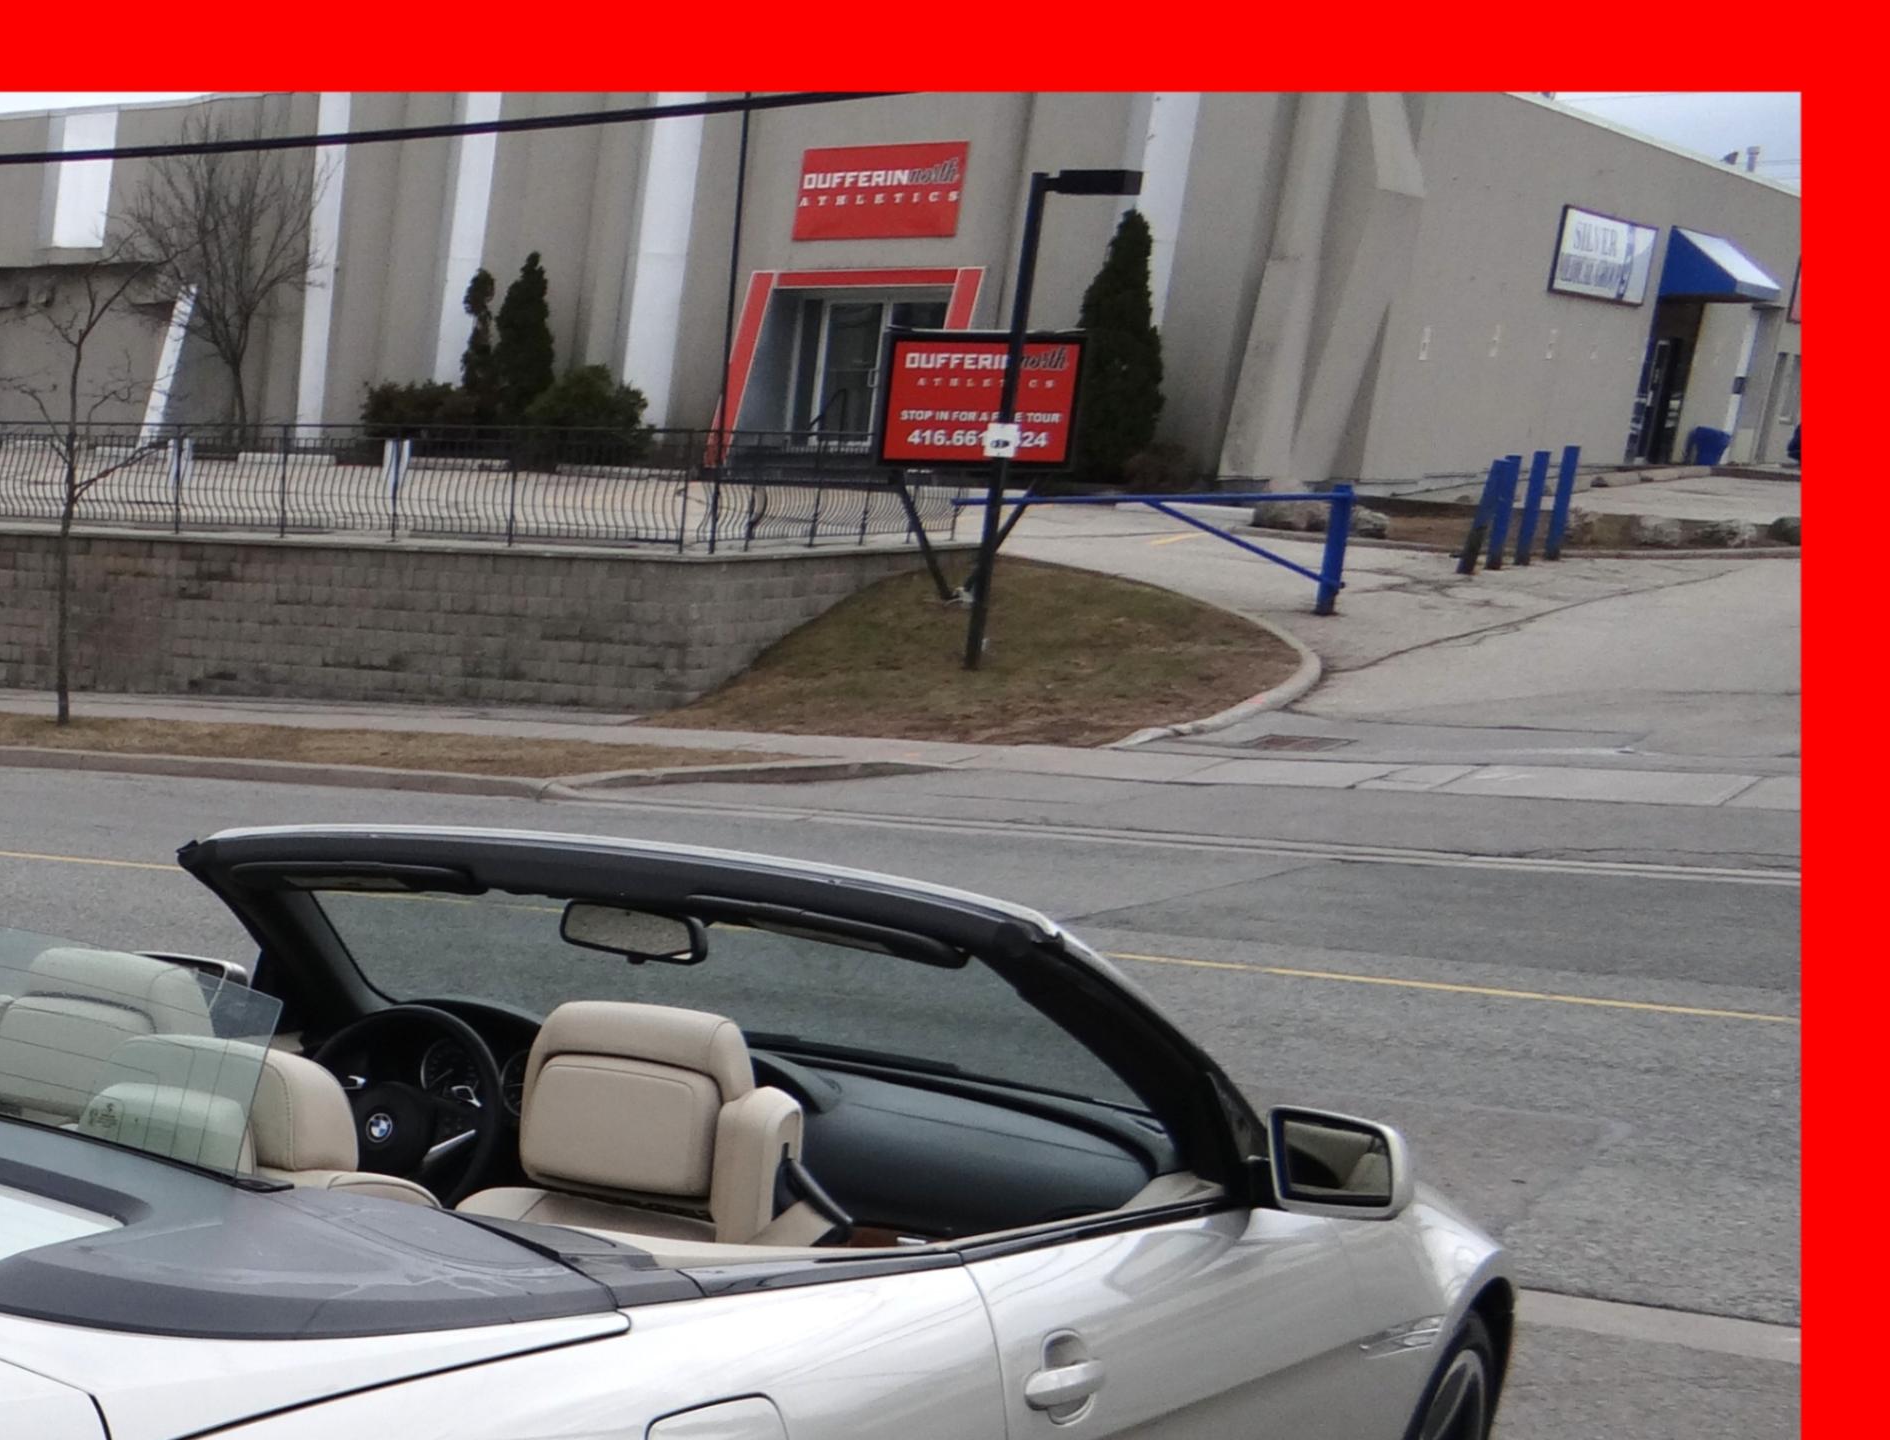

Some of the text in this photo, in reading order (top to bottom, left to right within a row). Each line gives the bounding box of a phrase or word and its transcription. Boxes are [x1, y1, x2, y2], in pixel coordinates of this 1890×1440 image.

[802, 169, 909, 190] DUFFERIN
[798, 191, 961, 207] ATHLETICS
[917, 378, 1055, 389] ATHLETCS
[900, 410, 1062, 423] STOP IN FOR A FE TOUR
